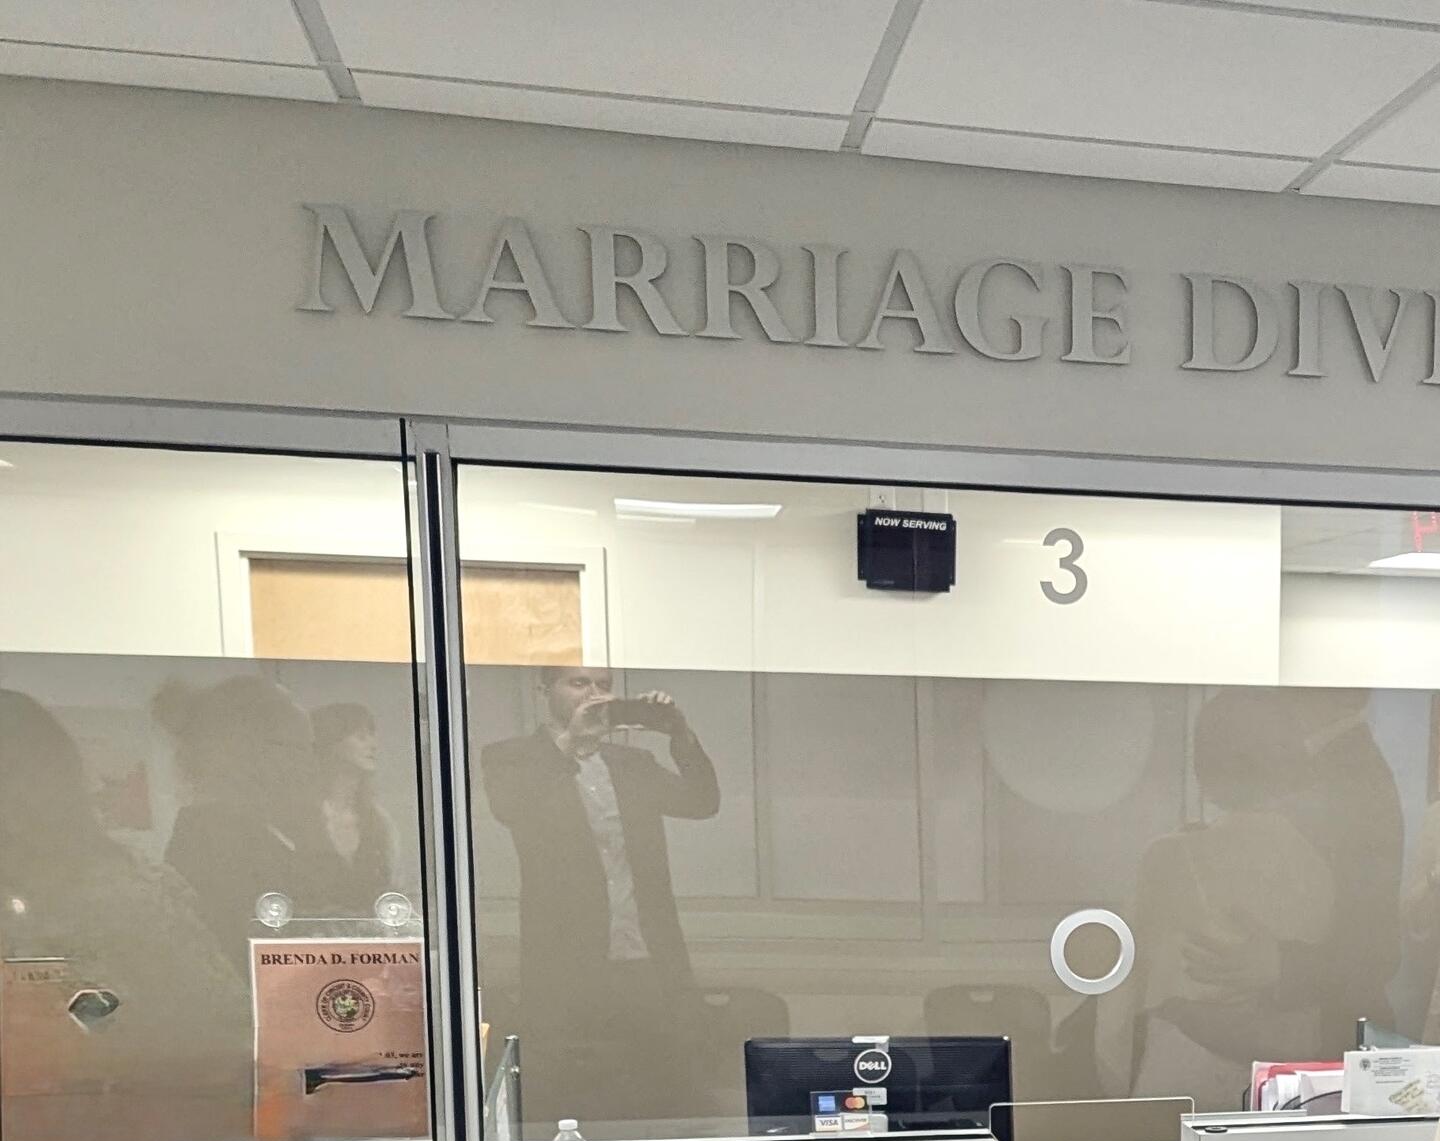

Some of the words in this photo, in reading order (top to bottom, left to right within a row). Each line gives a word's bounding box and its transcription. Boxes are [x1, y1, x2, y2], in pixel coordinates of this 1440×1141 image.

[296, 203, 1132, 366] MARRIAGE
[875, 517, 900, 527] NOW
[902, 519, 947, 531] SERVING
[1040, 527, 1088, 605] 3
[261, 953, 328, 965] BRENDA
[331, 953, 346, 965] D.
[350, 952, 419, 964] FORMAN
[858, 1061, 887, 1071] DELL
